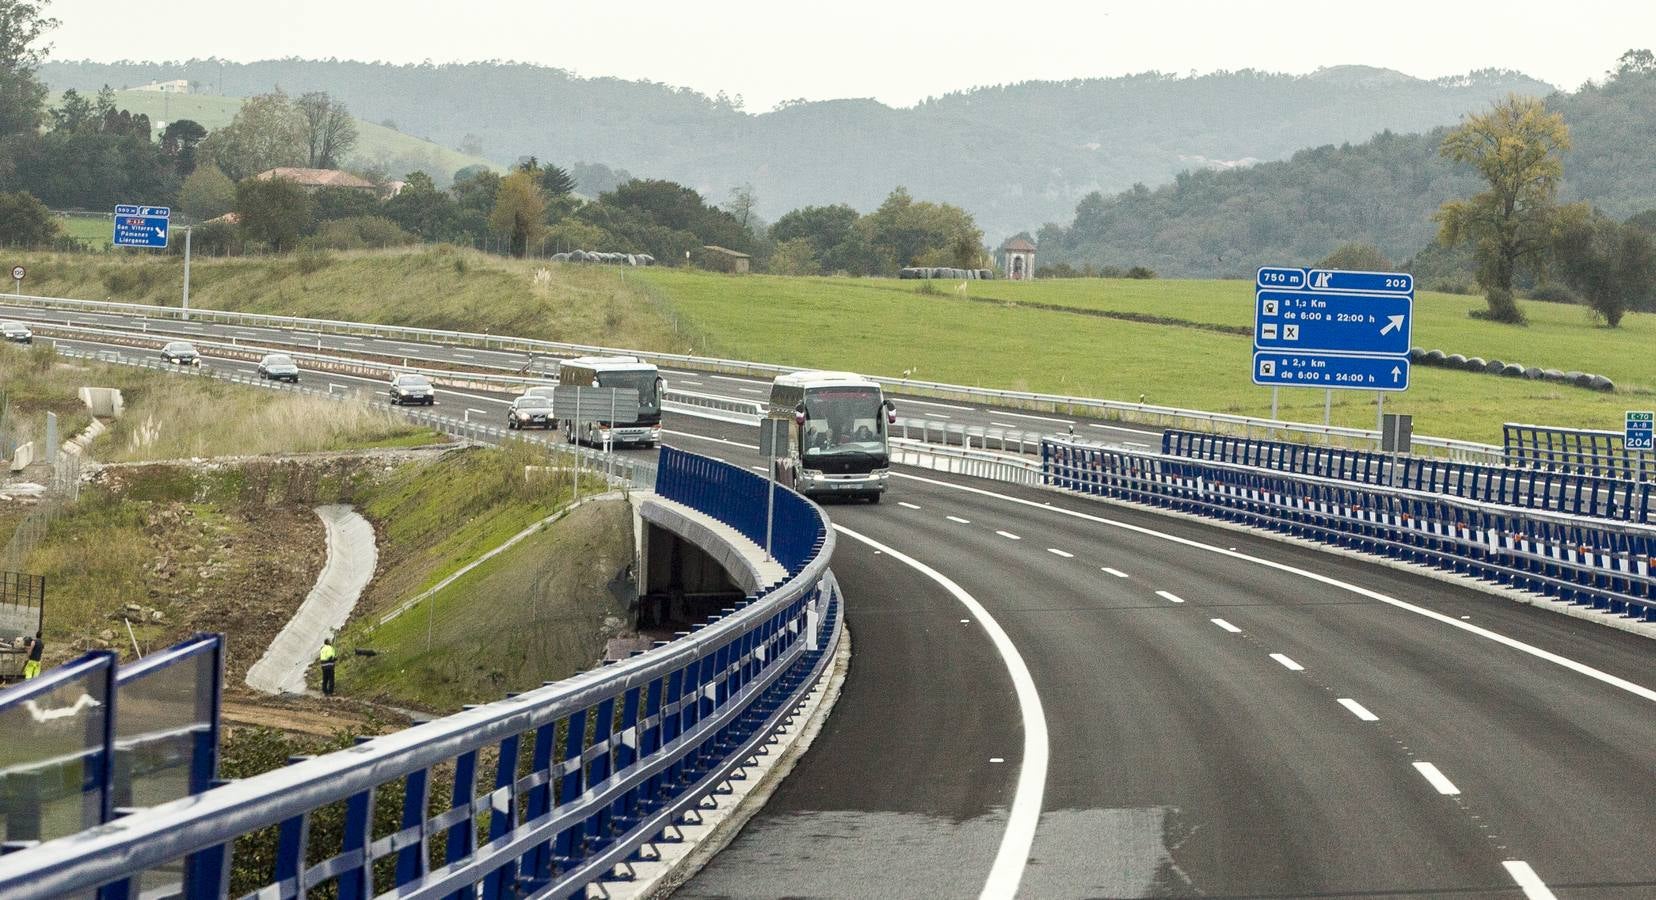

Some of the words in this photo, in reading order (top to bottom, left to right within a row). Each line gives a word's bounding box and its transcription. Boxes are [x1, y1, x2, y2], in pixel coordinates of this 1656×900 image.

[1264, 273, 1284, 281] 750
[1386, 279, 1406, 287] 202
[1311, 300, 1326, 308] Km
[1336, 374, 1364, 382] 24:00
[1628, 438, 1650, 447] 204
